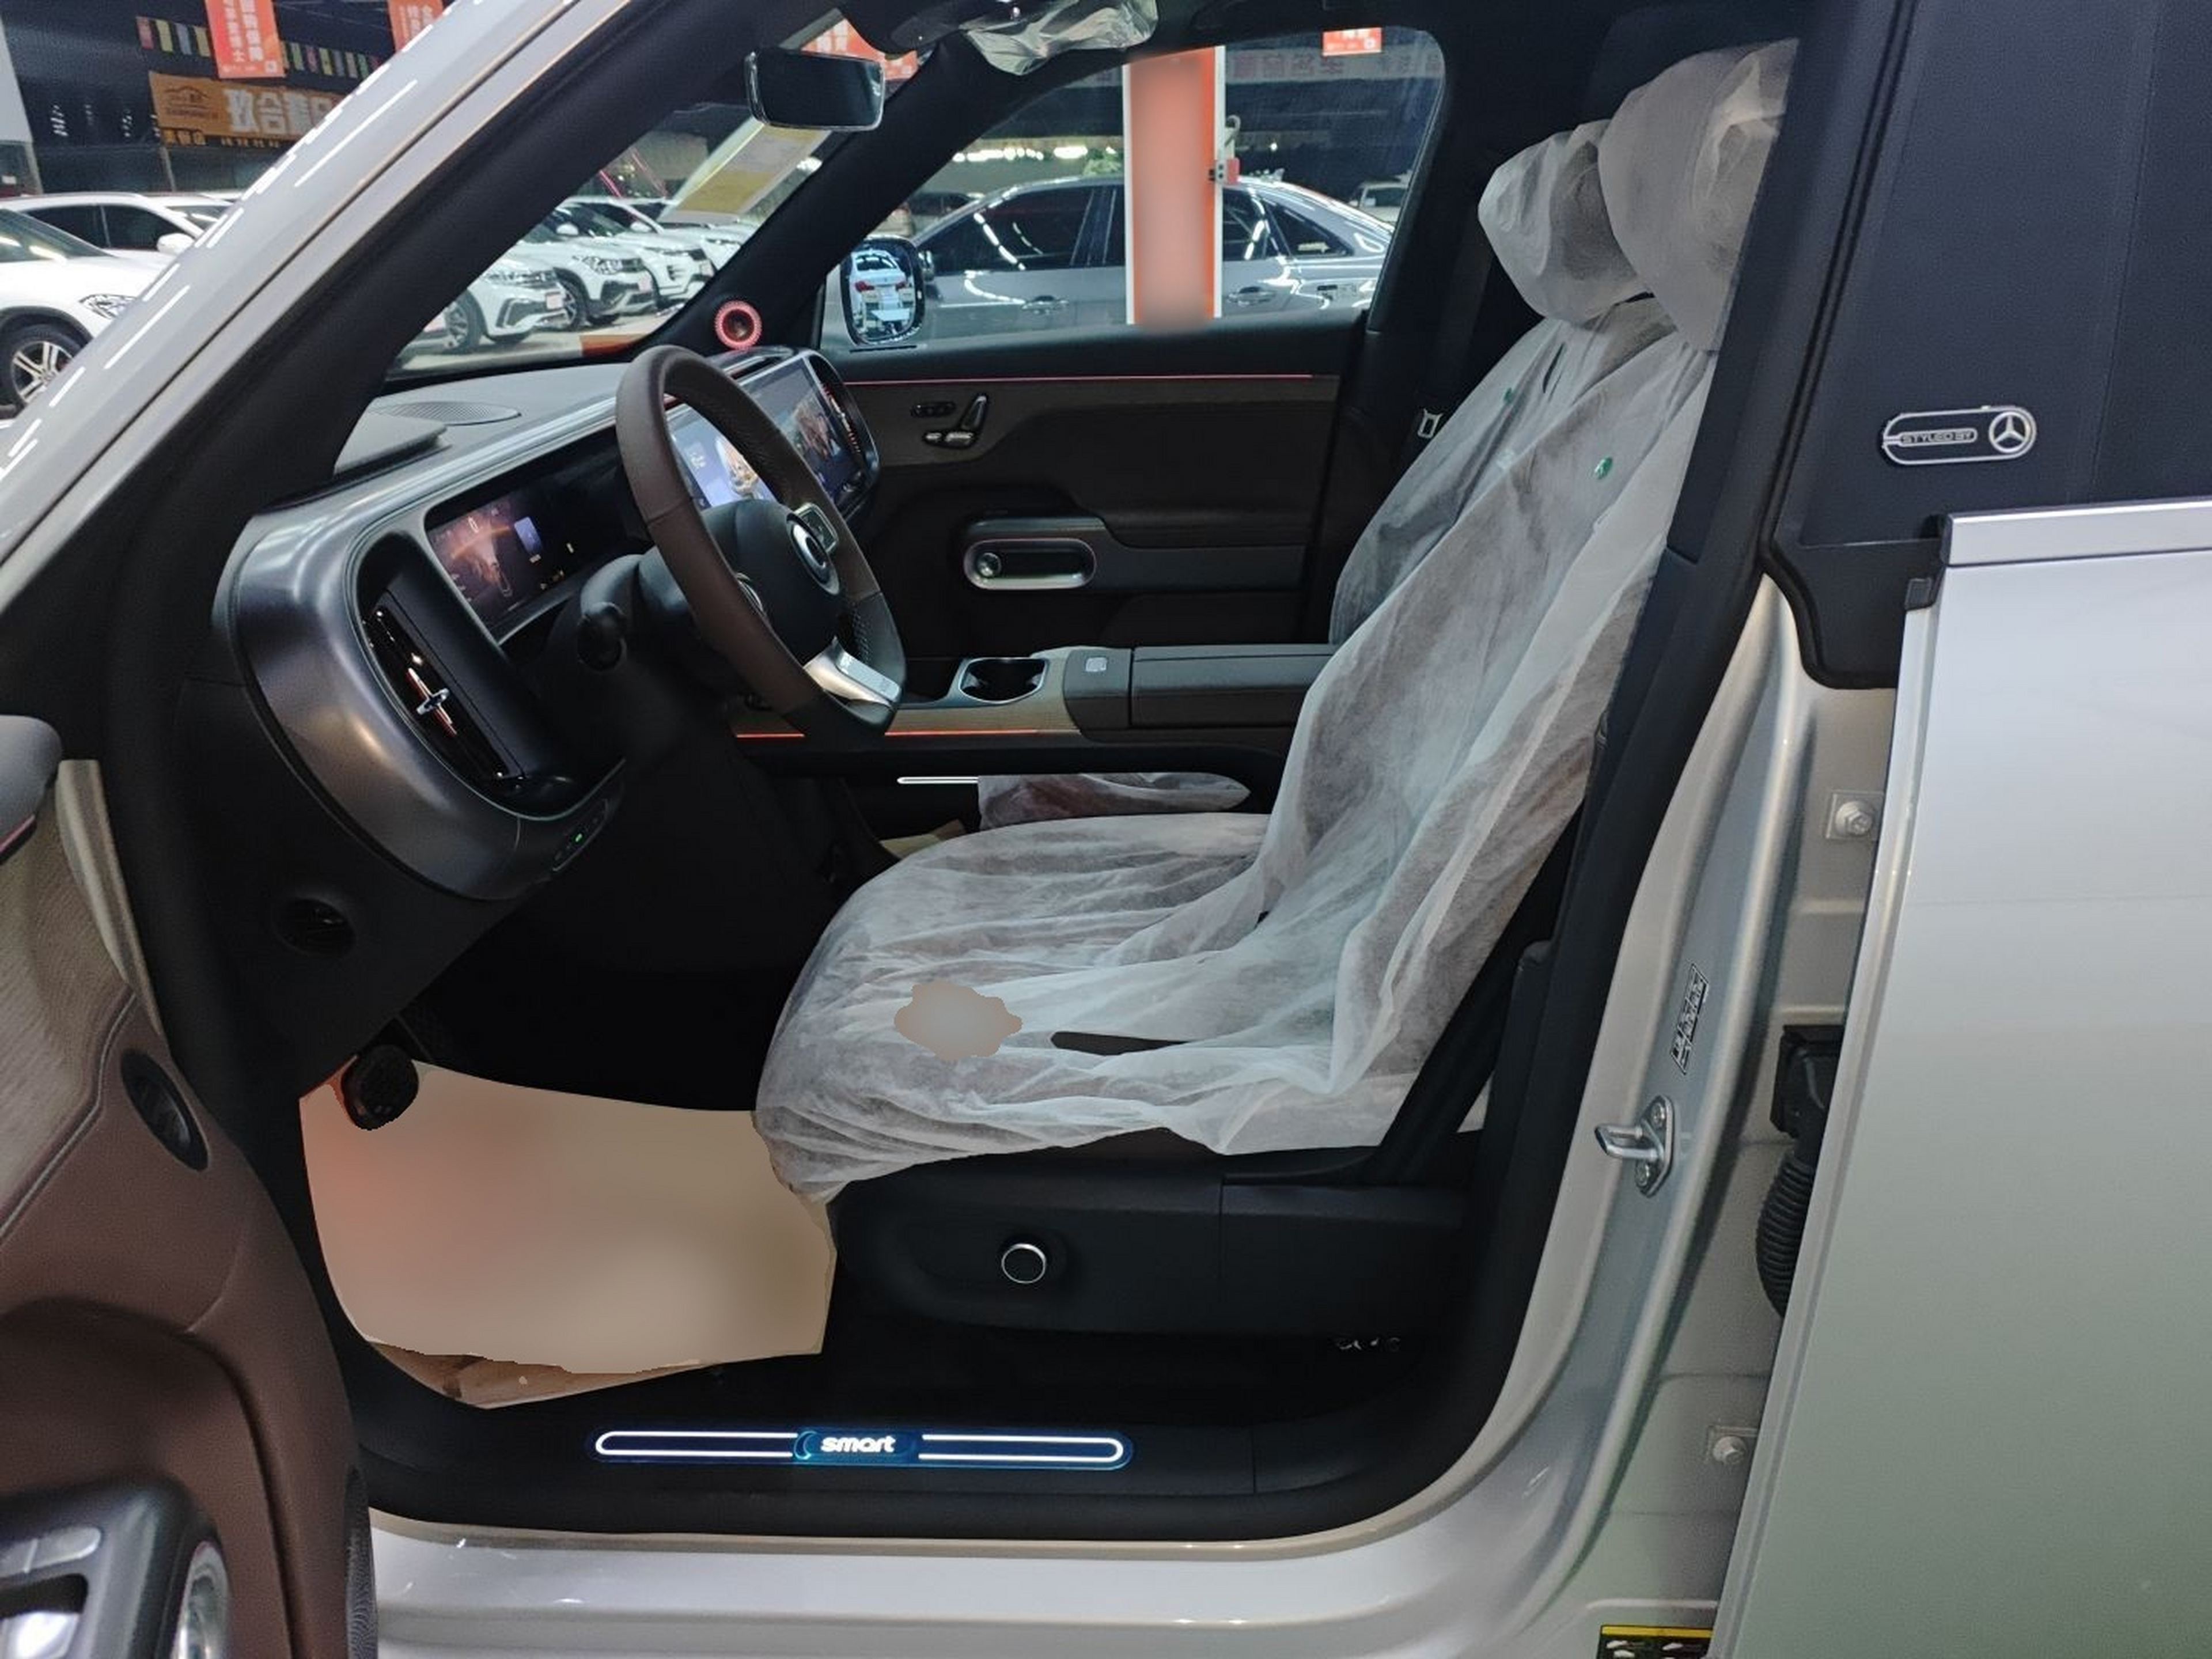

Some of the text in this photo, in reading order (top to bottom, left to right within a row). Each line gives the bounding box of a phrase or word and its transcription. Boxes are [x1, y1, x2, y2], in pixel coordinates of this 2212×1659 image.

[1903, 431, 1971, 444] STYLED BY
[821, 1435, 896, 1452] smart
